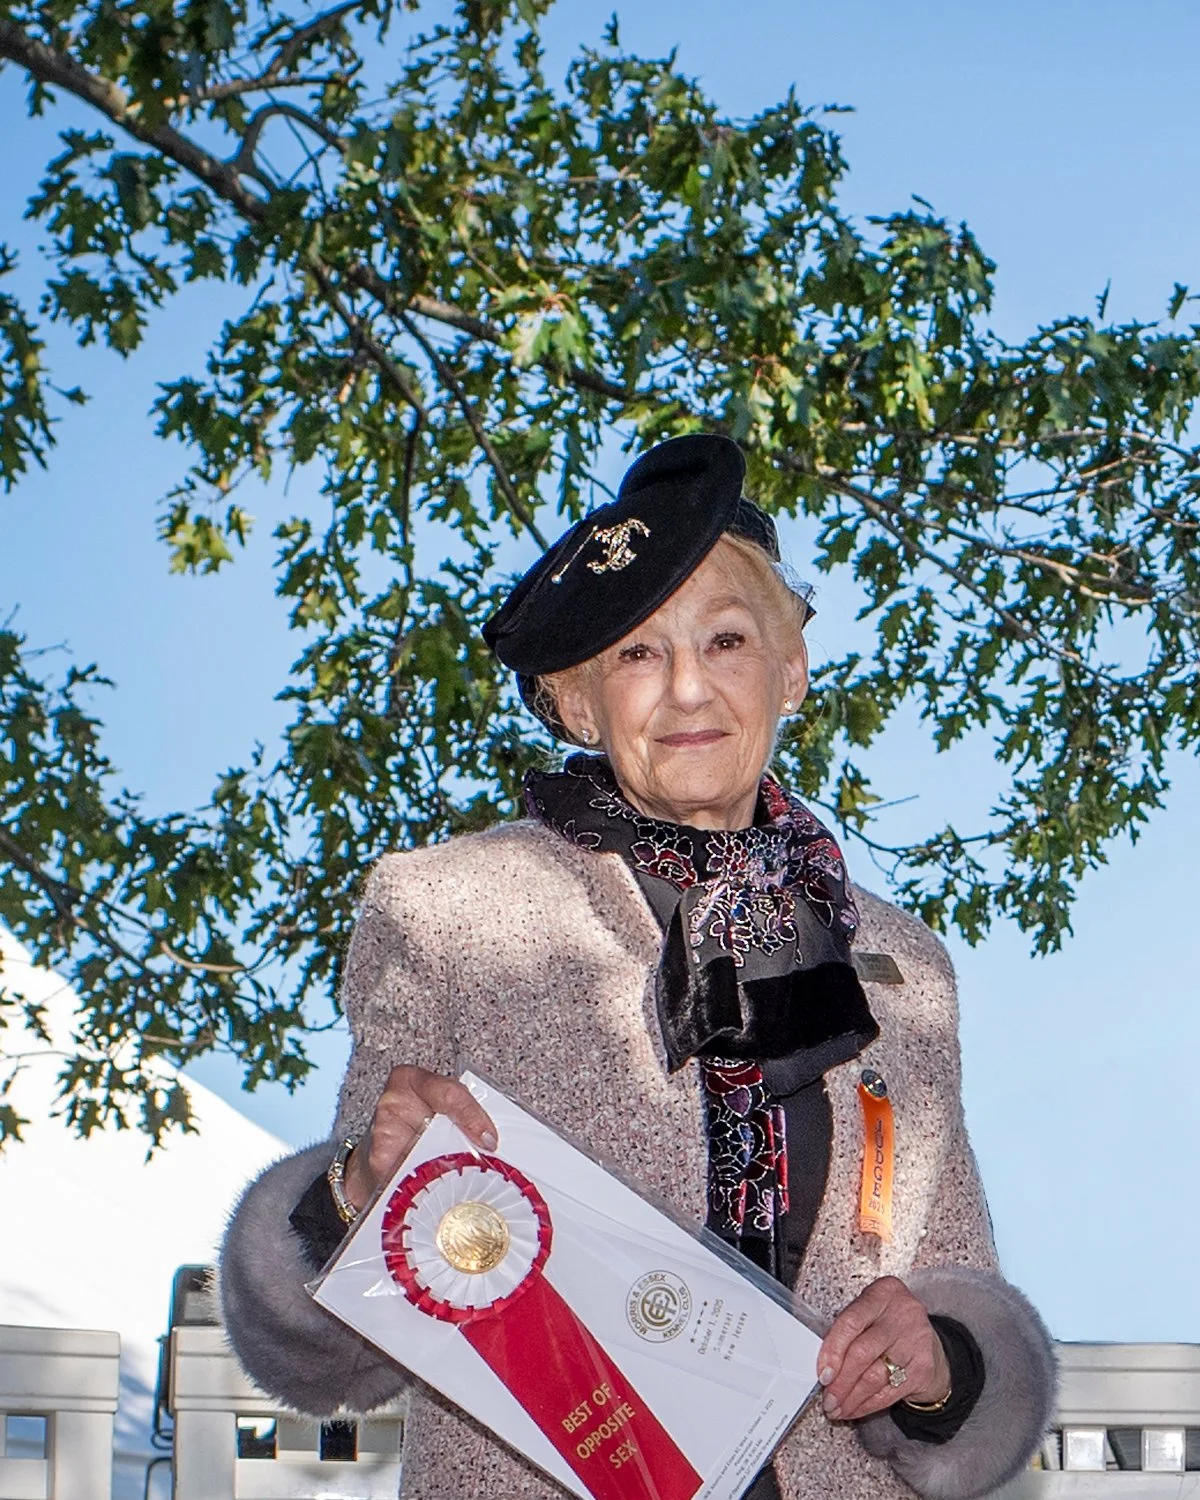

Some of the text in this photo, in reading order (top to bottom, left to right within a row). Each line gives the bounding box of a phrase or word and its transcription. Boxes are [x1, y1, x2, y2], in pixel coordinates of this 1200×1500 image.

[872, 1118, 885, 1198] JUDGE
[561, 1382, 612, 1434] BEST OF
[576, 1402, 636, 1459] OPPOSITE
[609, 1438, 637, 1469] SEX
